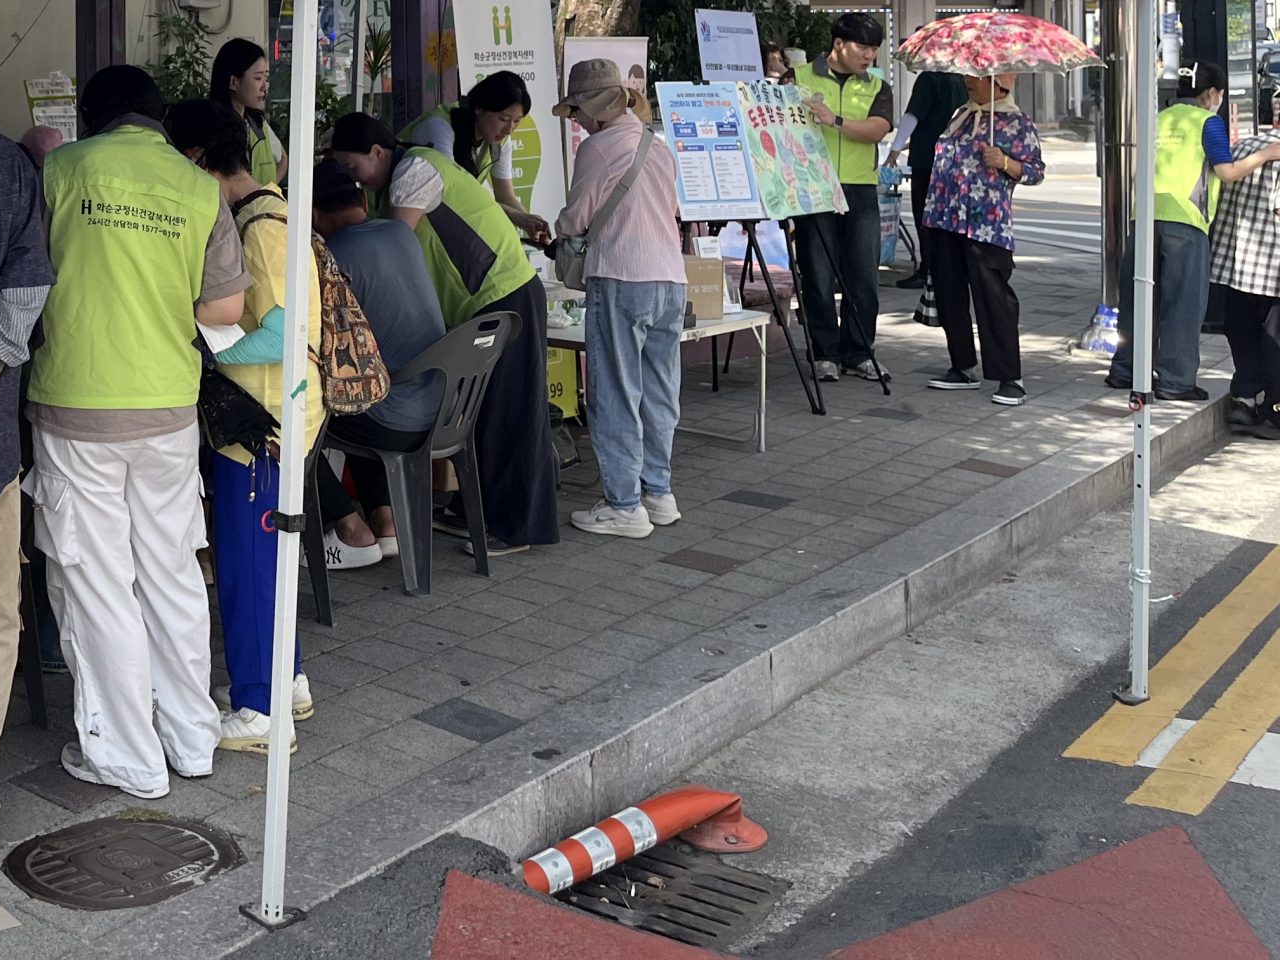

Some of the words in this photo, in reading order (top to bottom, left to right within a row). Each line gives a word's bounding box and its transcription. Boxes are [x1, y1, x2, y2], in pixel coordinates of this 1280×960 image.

[96, 202, 187, 228] 화순군정신건강복지센터
[87, 217, 111, 227] 24시간
[112, 219, 139, 230] 상담전화
[141, 224, 181, 239] 1577-0199
